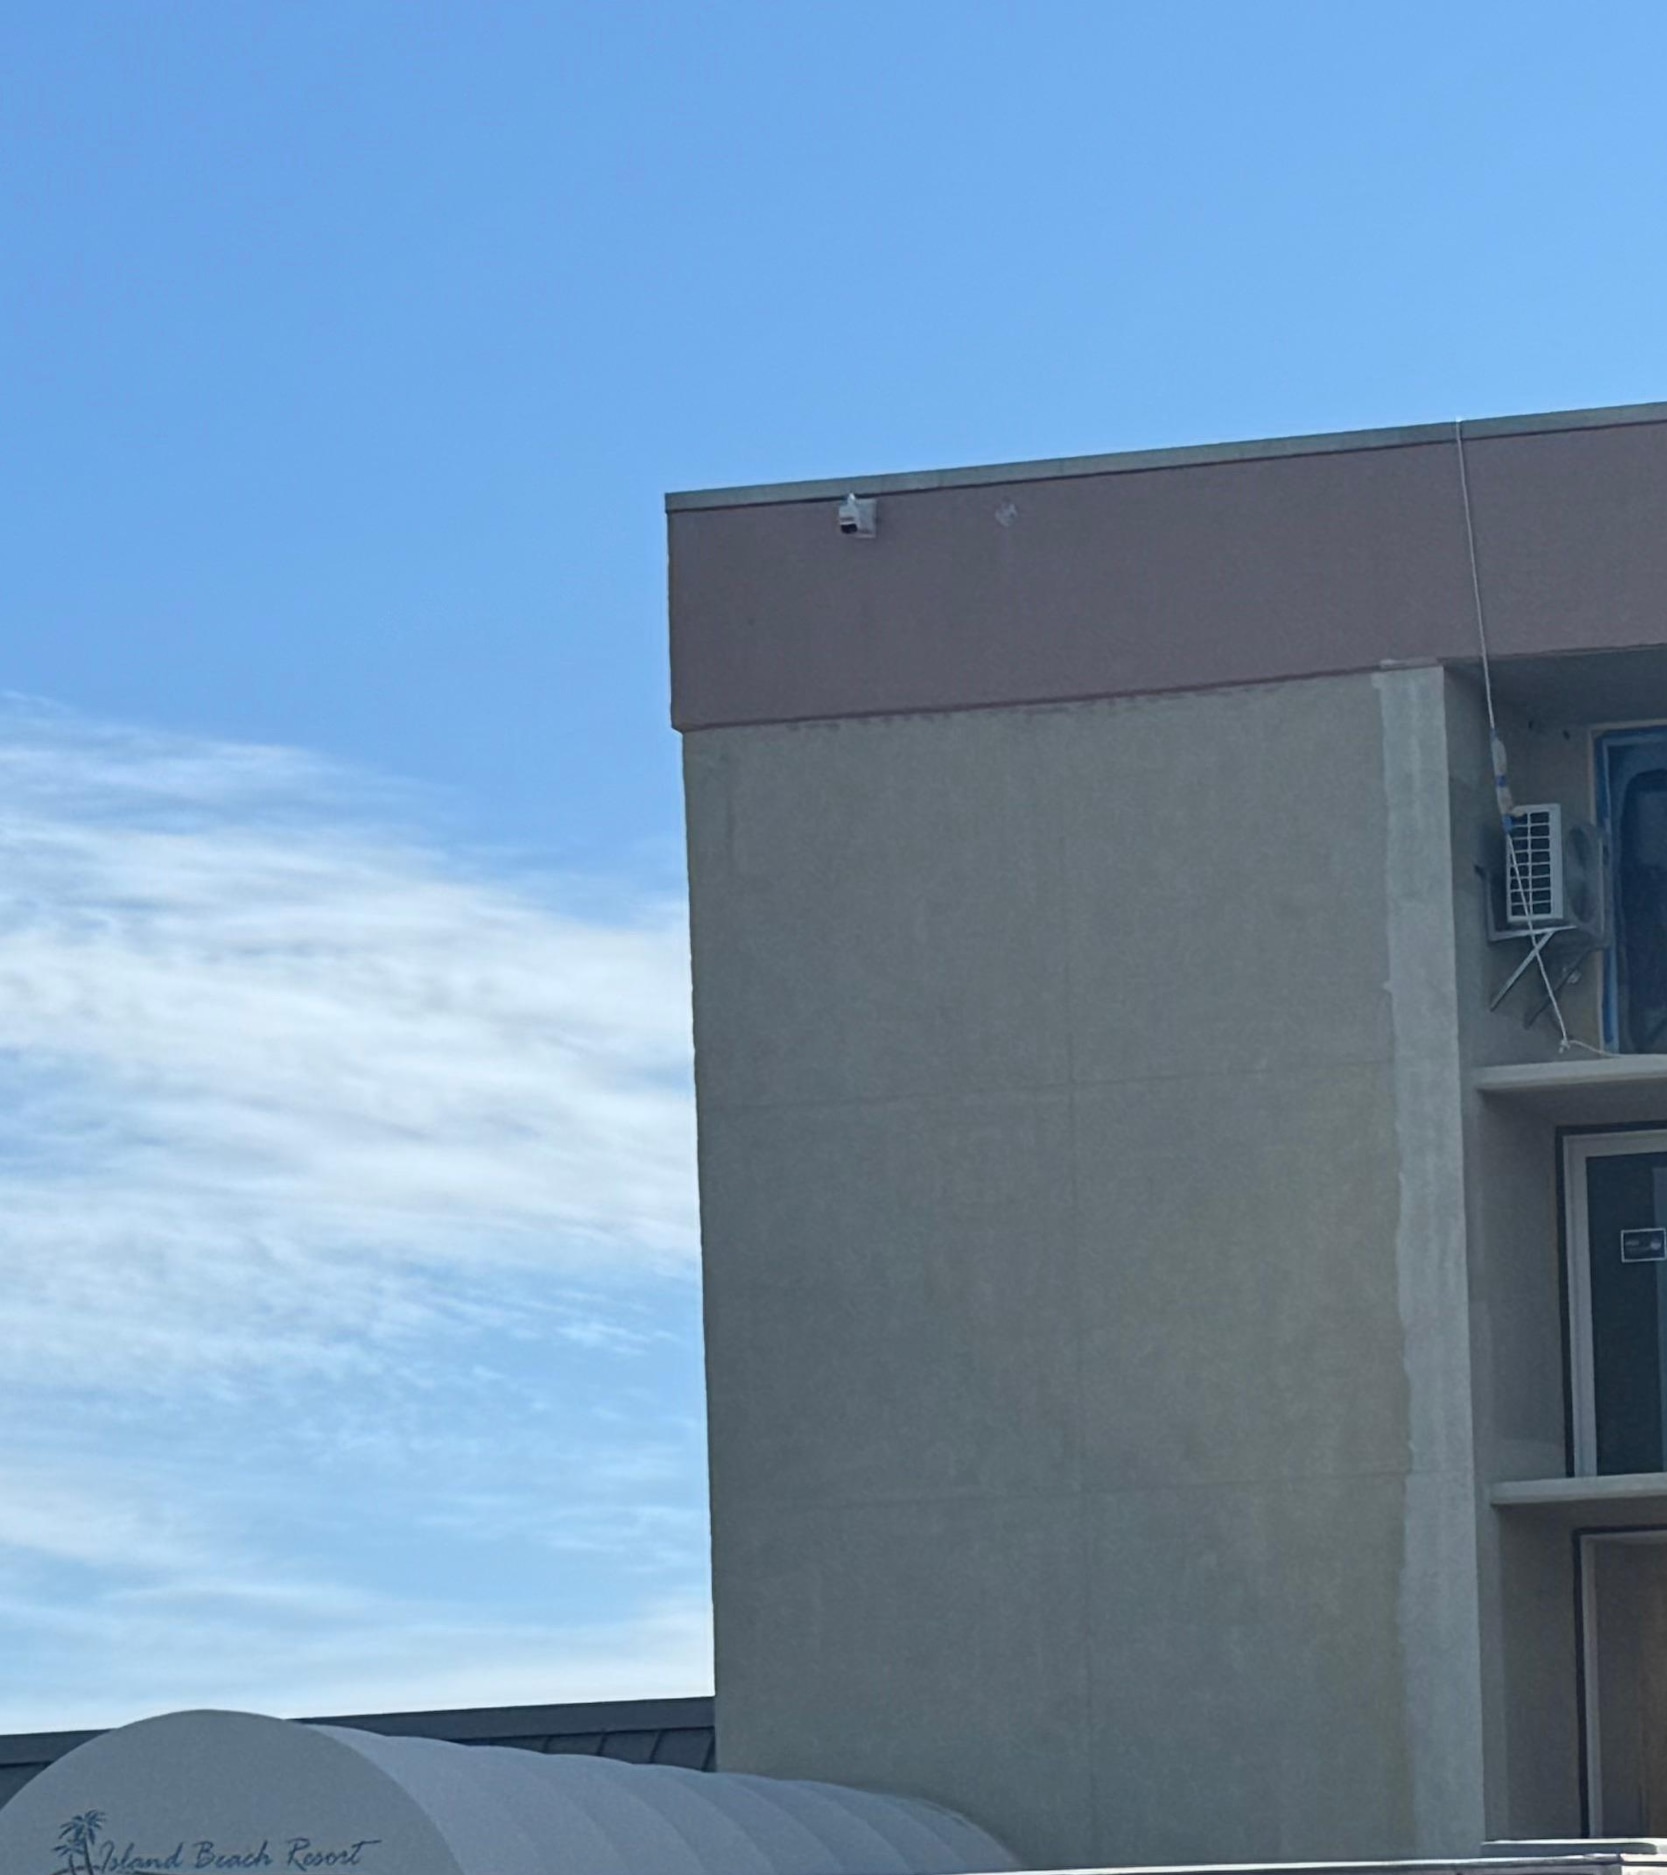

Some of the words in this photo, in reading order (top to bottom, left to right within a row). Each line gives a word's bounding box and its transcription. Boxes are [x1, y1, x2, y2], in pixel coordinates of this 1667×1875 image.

[100, 1839, 184, 1874] Island
[192, 1839, 274, 1870] Beach
[287, 1836, 383, 1873] Resort
